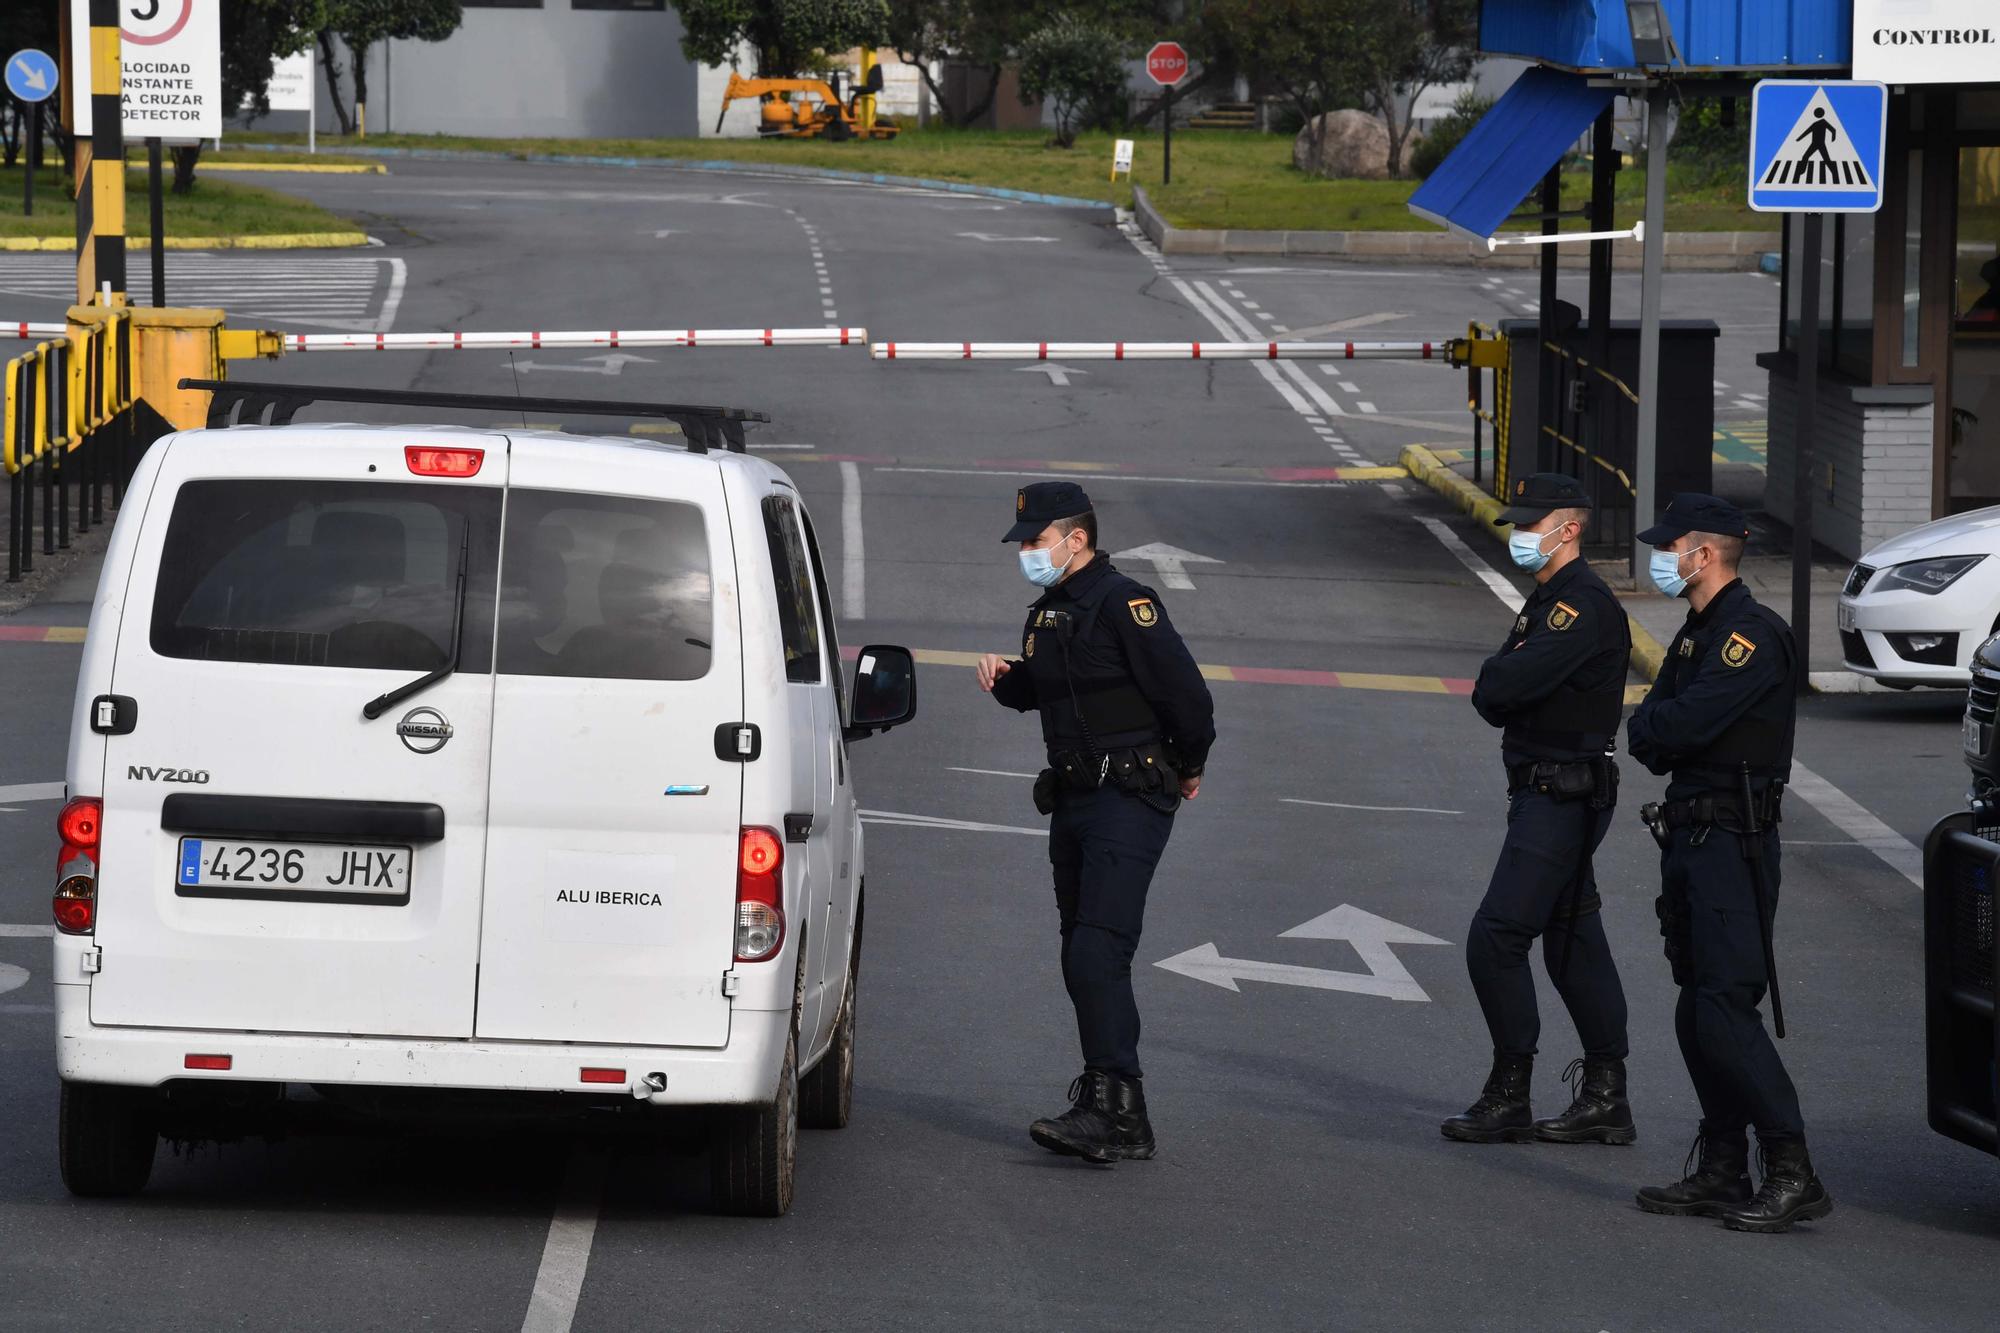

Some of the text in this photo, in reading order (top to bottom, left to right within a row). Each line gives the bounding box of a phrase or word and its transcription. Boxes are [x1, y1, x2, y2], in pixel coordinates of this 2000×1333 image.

[1872, 28, 1996, 46] CONTROL
[121, 62, 191, 74] LOCIDAD
[1151, 58, 1185, 69] STOP
[121, 78, 193, 90] NSTANTE
[139, 94, 203, 106] CRUZAR
[120, 109, 201, 121] DETECTOR
[402, 725, 448, 735] NISSAN
[127, 765, 210, 784] NV200
[186, 866, 195, 877] E
[209, 846, 397, 888] 4236 JHX
[556, 889, 663, 906] ALU IBERICA
